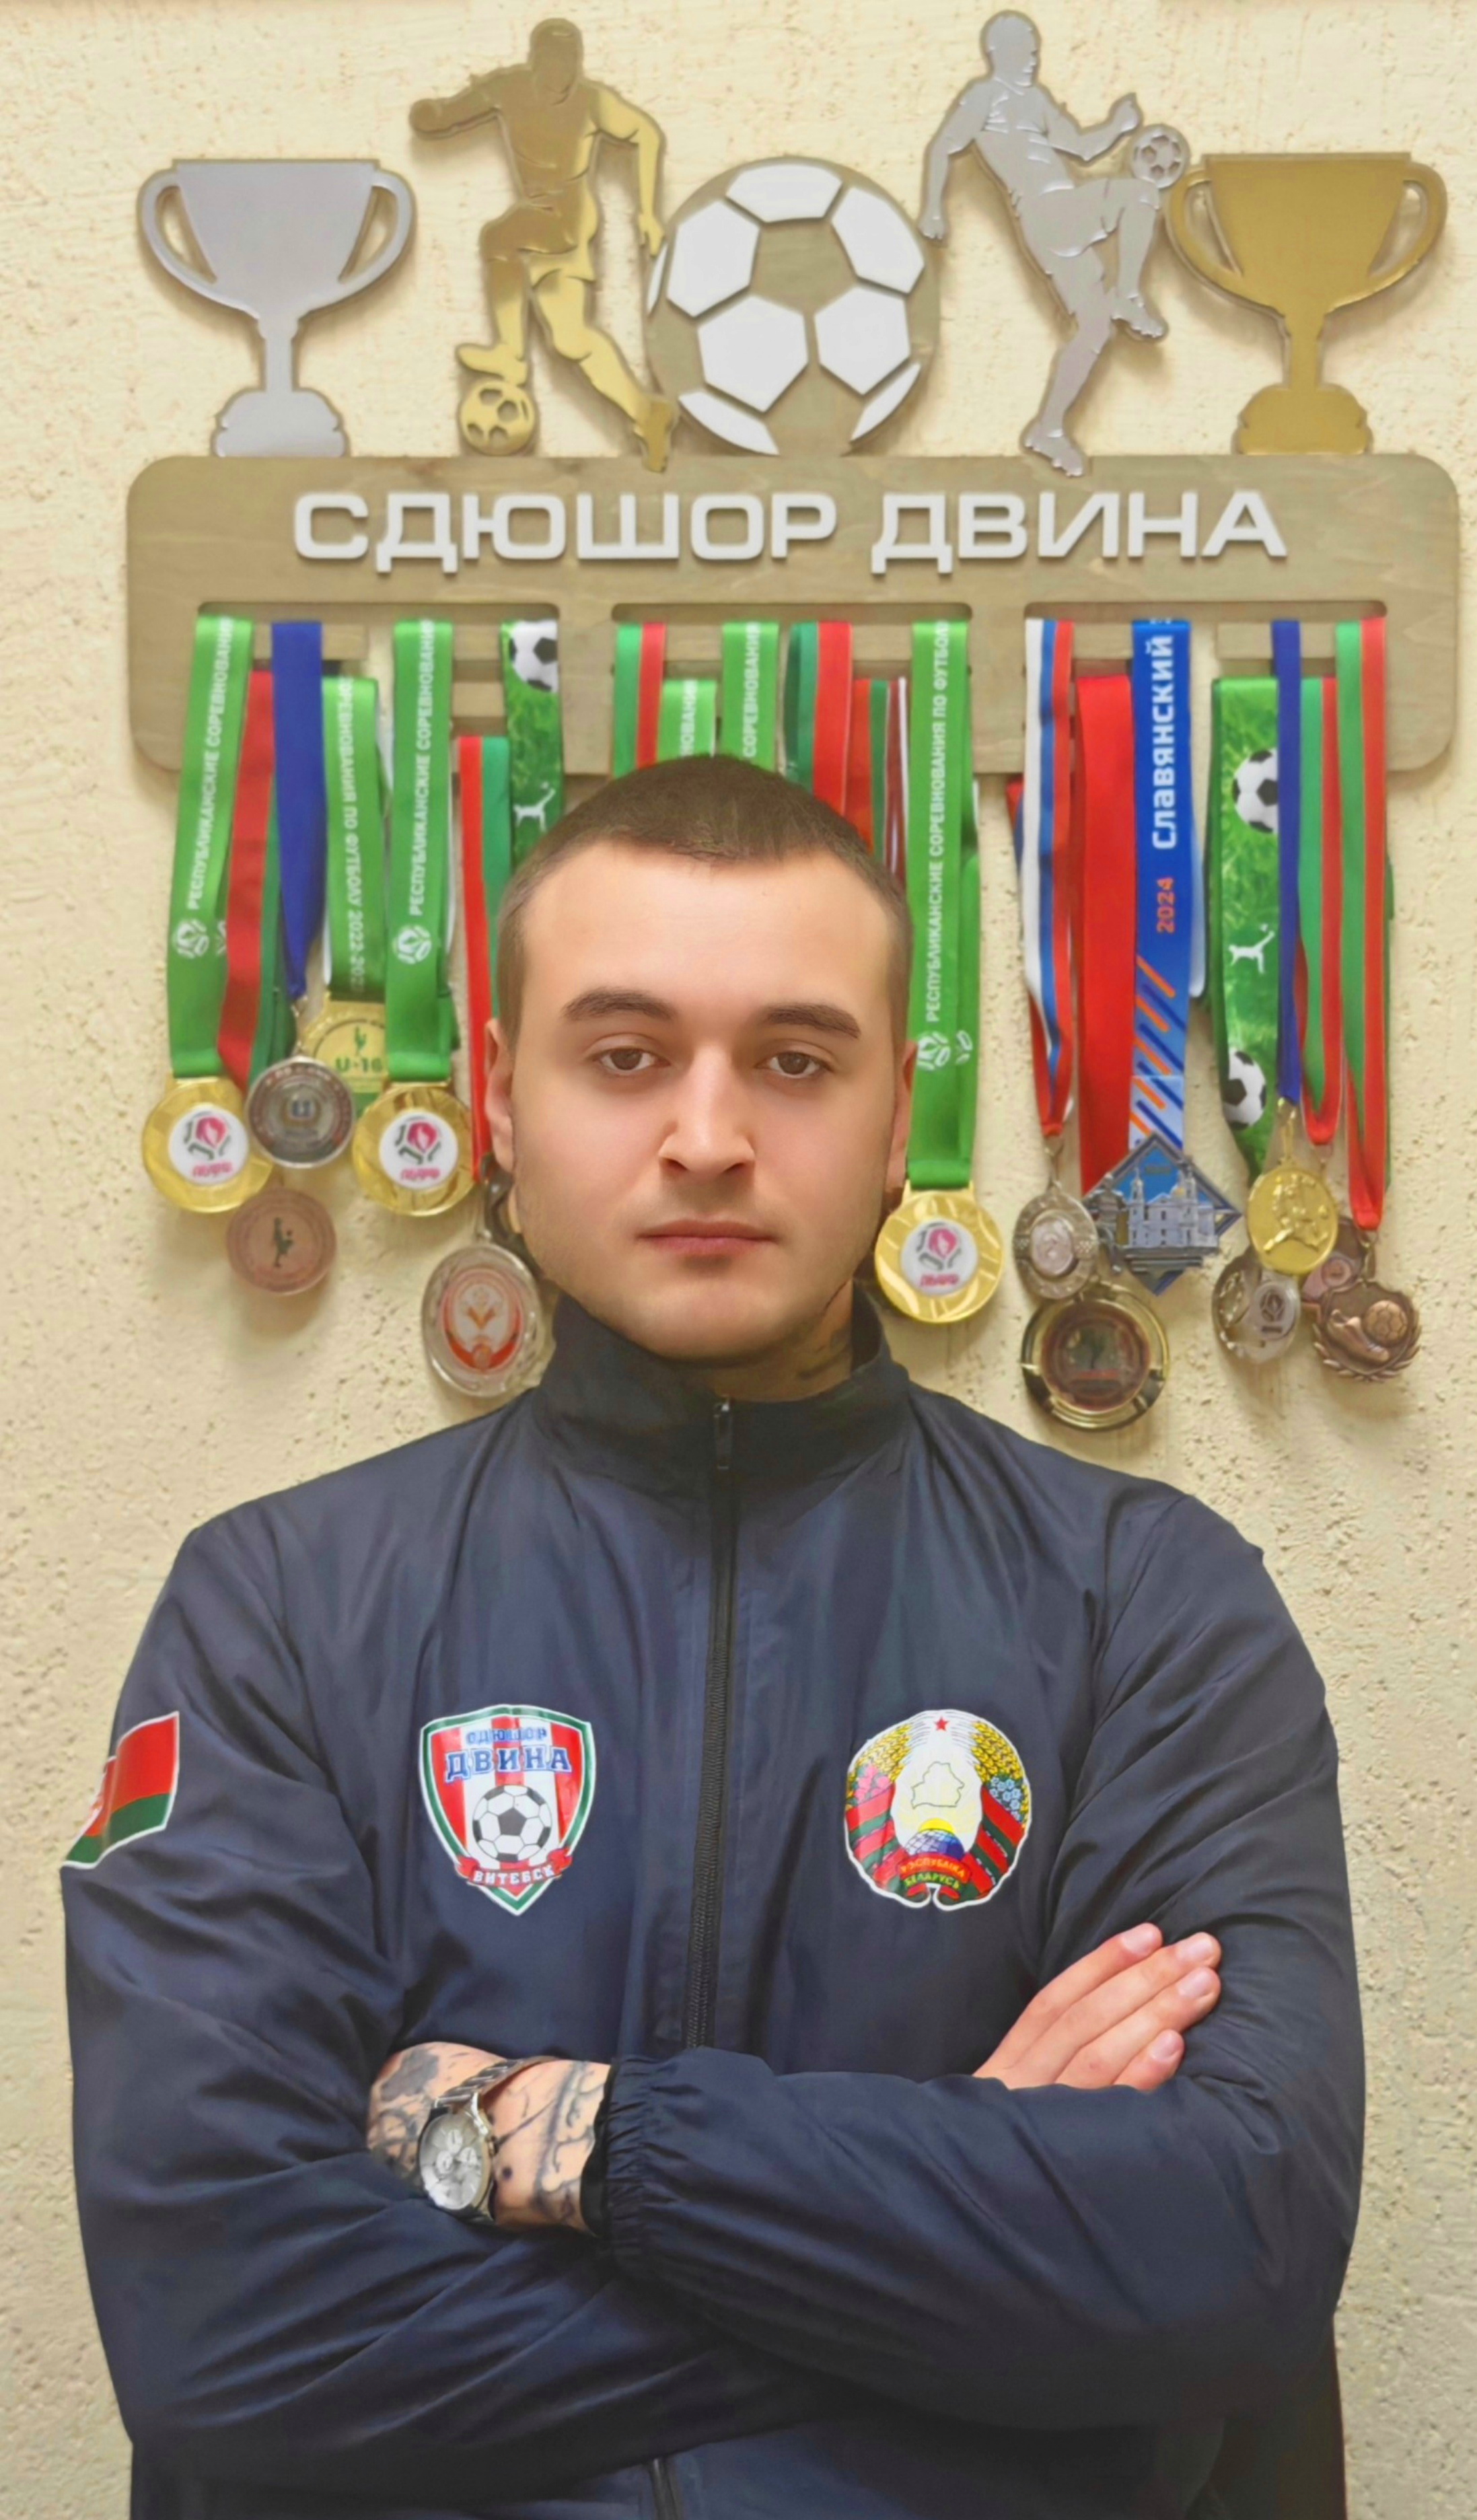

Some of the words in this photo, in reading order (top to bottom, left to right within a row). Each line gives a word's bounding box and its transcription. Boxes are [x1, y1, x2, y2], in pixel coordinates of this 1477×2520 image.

[293, 492, 838, 573] СДЮШОР
[871, 492, 1288, 574] ДВИНА
[933, 694, 947, 718] ПО
[344, 809, 358, 830] ПО
[929, 721, 946, 857] СОРЕВНОВАНИЯ
[188, 750, 219, 910] РЕСПУБЛИКАНСКИЕ
[409, 754, 431, 916] РЕСПУБЛИКАНСКИЕ
[345, 832, 364, 908] ФУТБОЛУ
[1156, 876, 1176, 934] 2024
[925, 861, 944, 1023] РЕСПУБЛИКАНСКИЕ
[445, 1745, 573, 1783] ДВИНА
[472, 1865, 555, 1885] ВИТЕБСК
